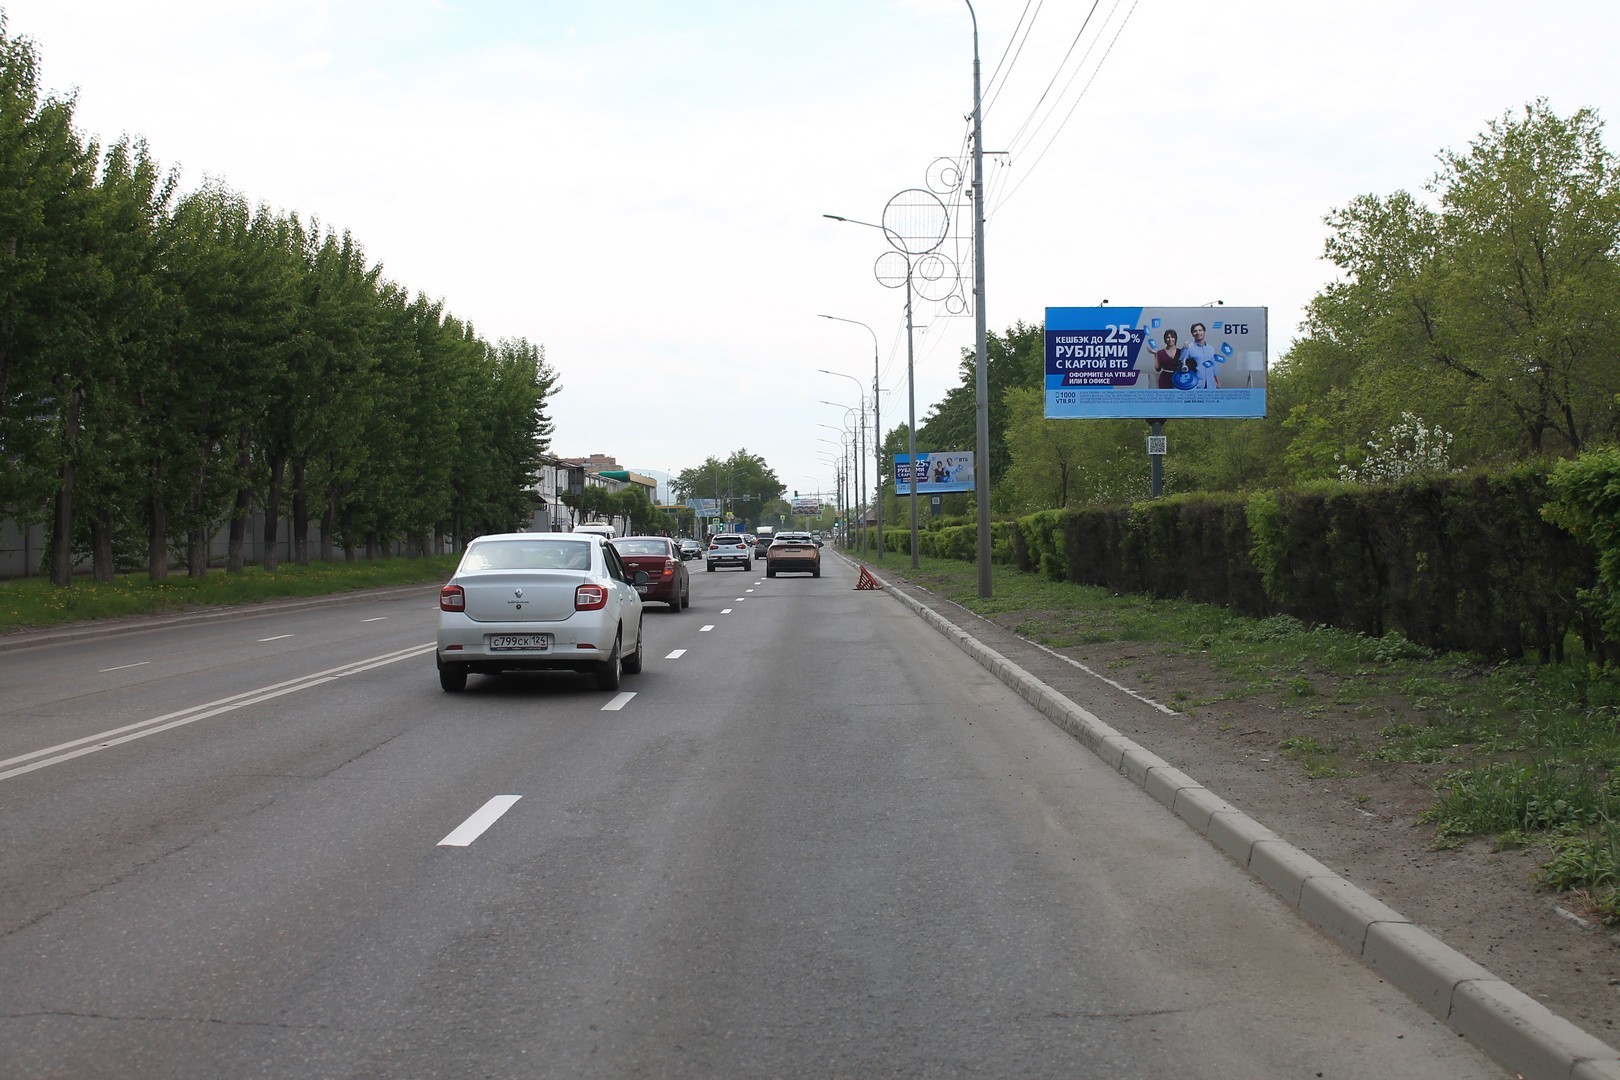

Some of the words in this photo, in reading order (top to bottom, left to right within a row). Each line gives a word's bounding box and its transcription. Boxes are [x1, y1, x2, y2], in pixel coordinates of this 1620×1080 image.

[1055, 336, 1089, 344] КЕШБЭК
[1090, 336, 1103, 345] ДО
[1105, 324, 1141, 344] 25%
[1224, 324, 1249, 335] ВТБ
[1056, 346, 1128, 358] РУБЛЯМИ
[1056, 359, 1063, 369] С
[1065, 357, 1107, 369] КАРТОЙ
[1109, 359, 1129, 369] ВТБ
